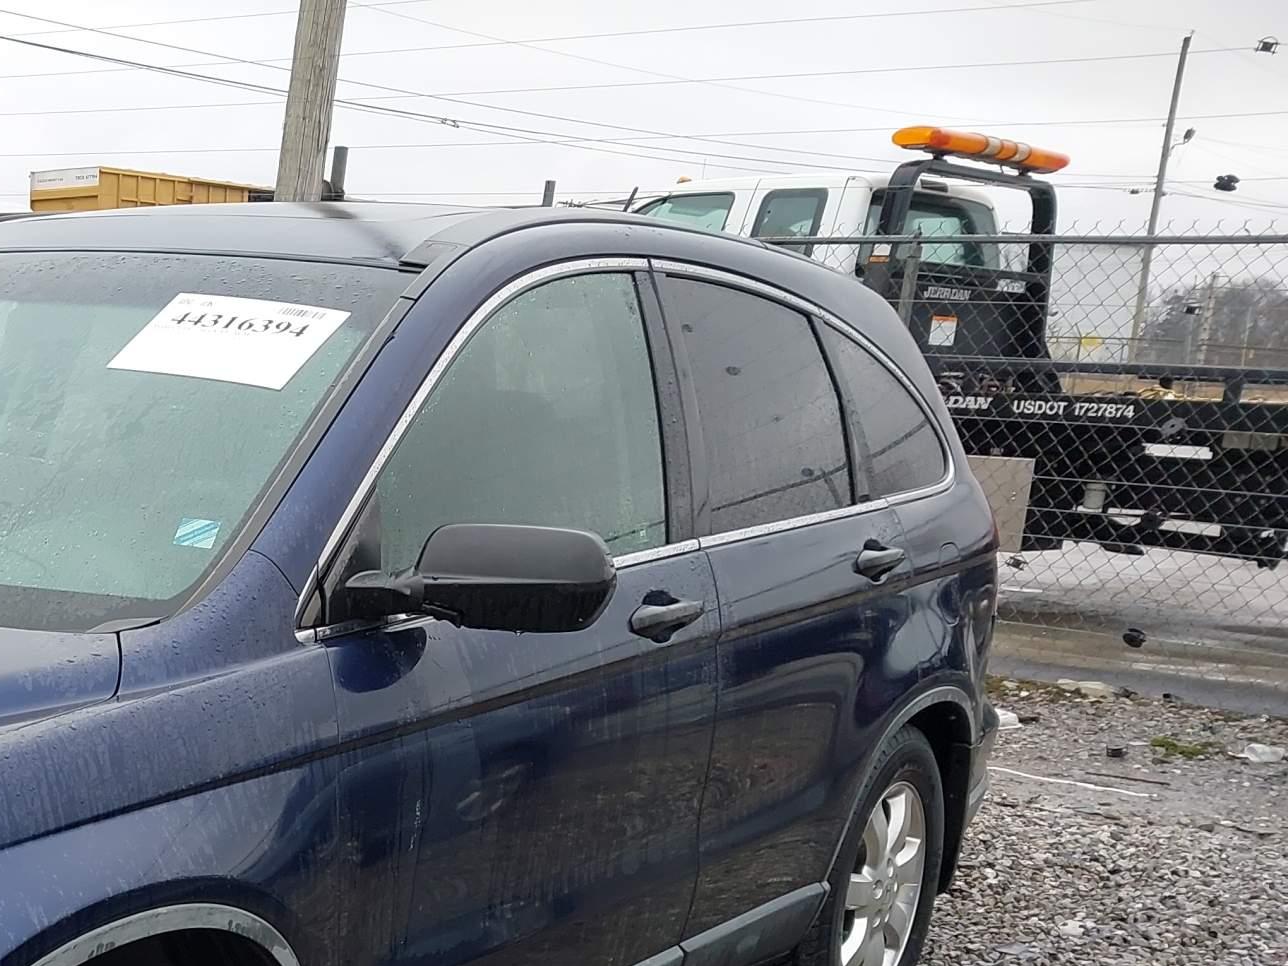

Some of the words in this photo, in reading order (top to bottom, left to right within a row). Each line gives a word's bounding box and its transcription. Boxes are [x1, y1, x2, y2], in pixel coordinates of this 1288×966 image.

[171, 311, 310, 337] 44316394
[1013, 399, 1068, 415] USDOT
[1073, 402, 1135, 418] 1727874
